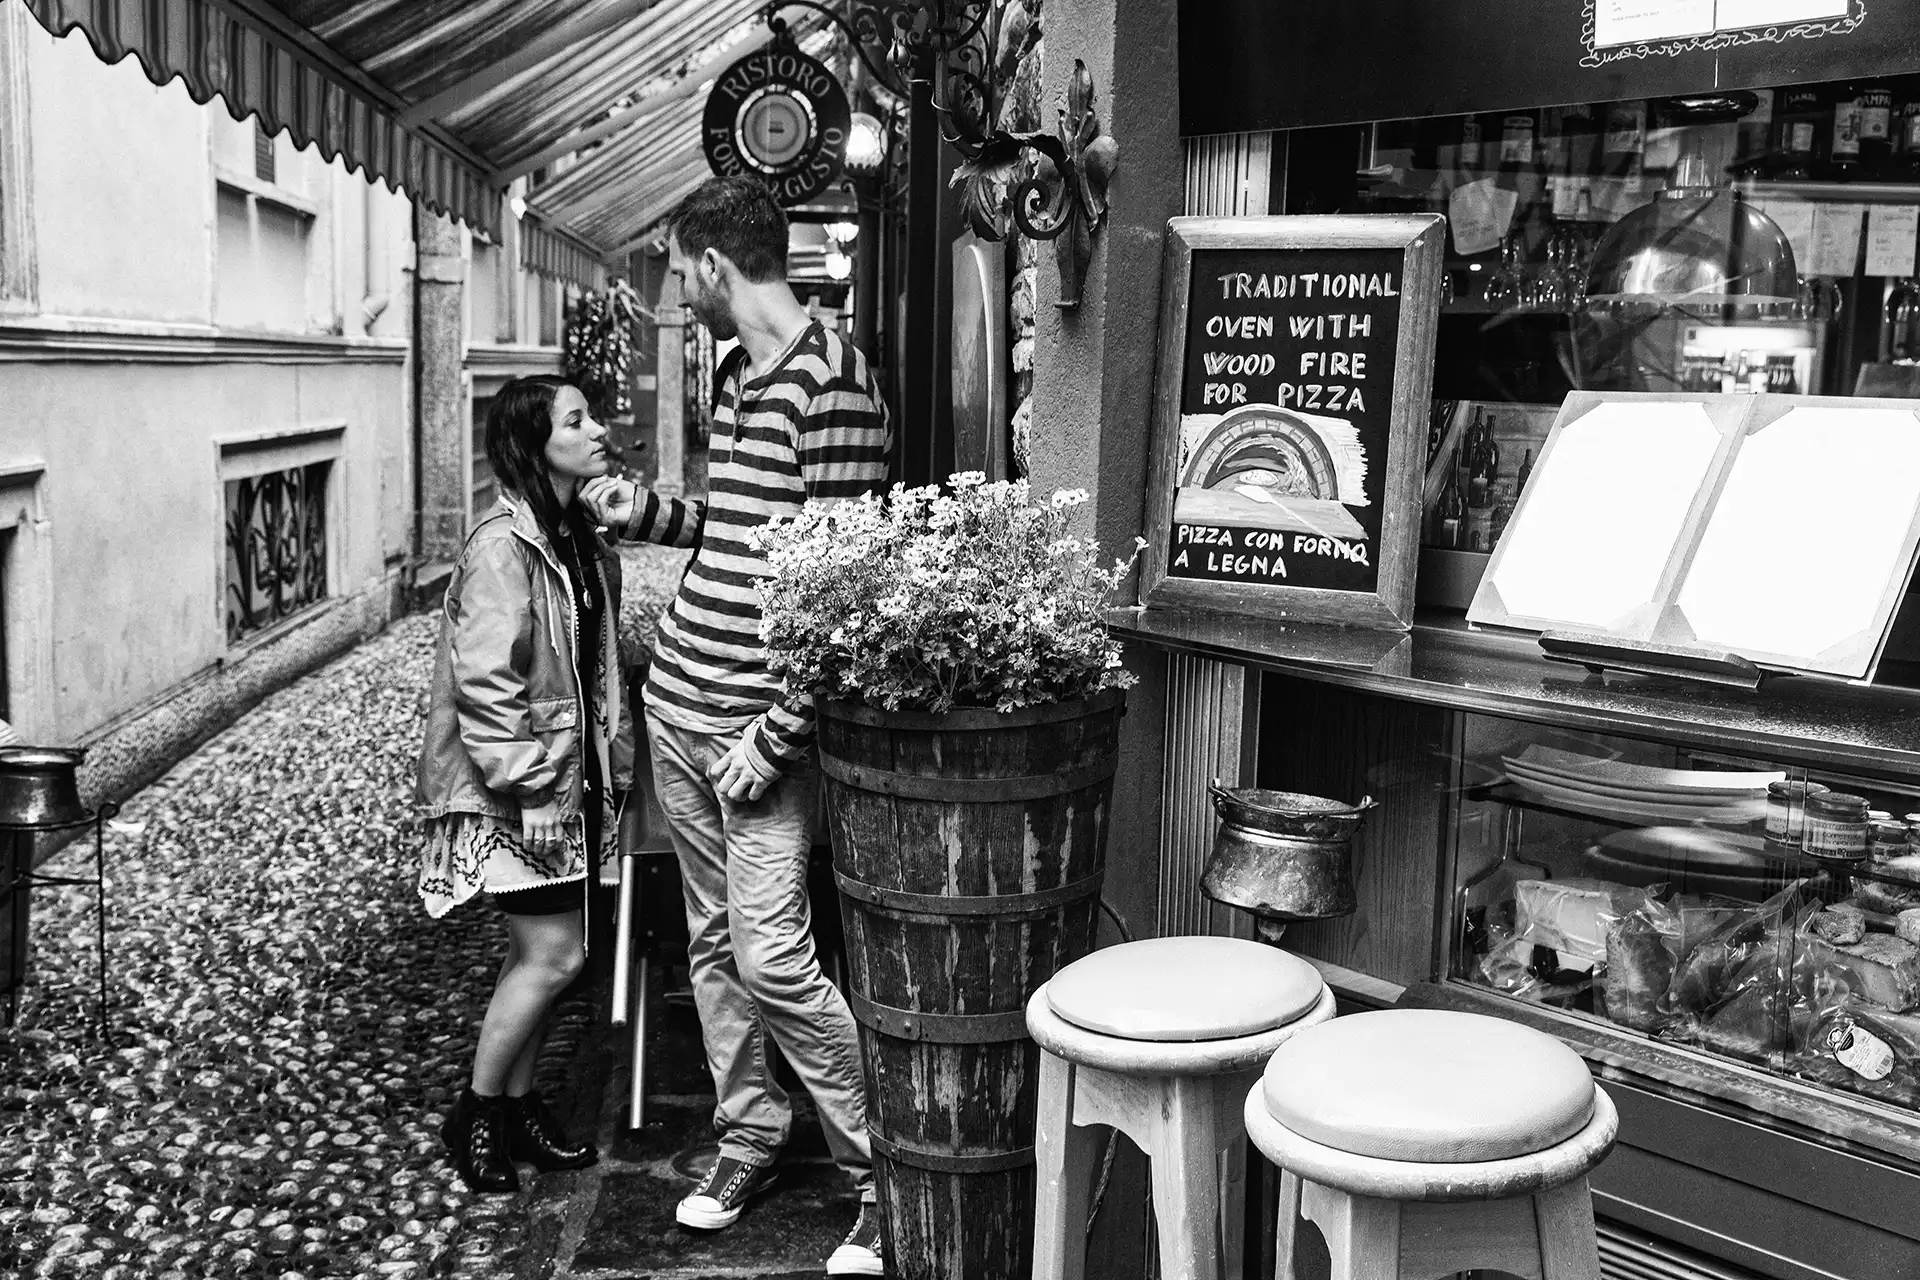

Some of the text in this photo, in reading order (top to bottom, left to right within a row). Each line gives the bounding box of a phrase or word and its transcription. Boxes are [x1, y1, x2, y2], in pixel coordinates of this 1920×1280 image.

[721, 55, 831, 100] RISTORO
[784, 127, 844, 198] GUSTO
[1217, 272, 1399, 299] TRADITIONAL
[1205, 314, 1371, 341] OVEN WITH
[1203, 351, 1366, 379] WOOD FIRE
[1203, 382, 1365, 412] FOR PIZZA
[1178, 524, 1233, 547] PIZZA
[1244, 532, 1284, 551] CON
[1174, 549, 1287, 578] A LEGNA
